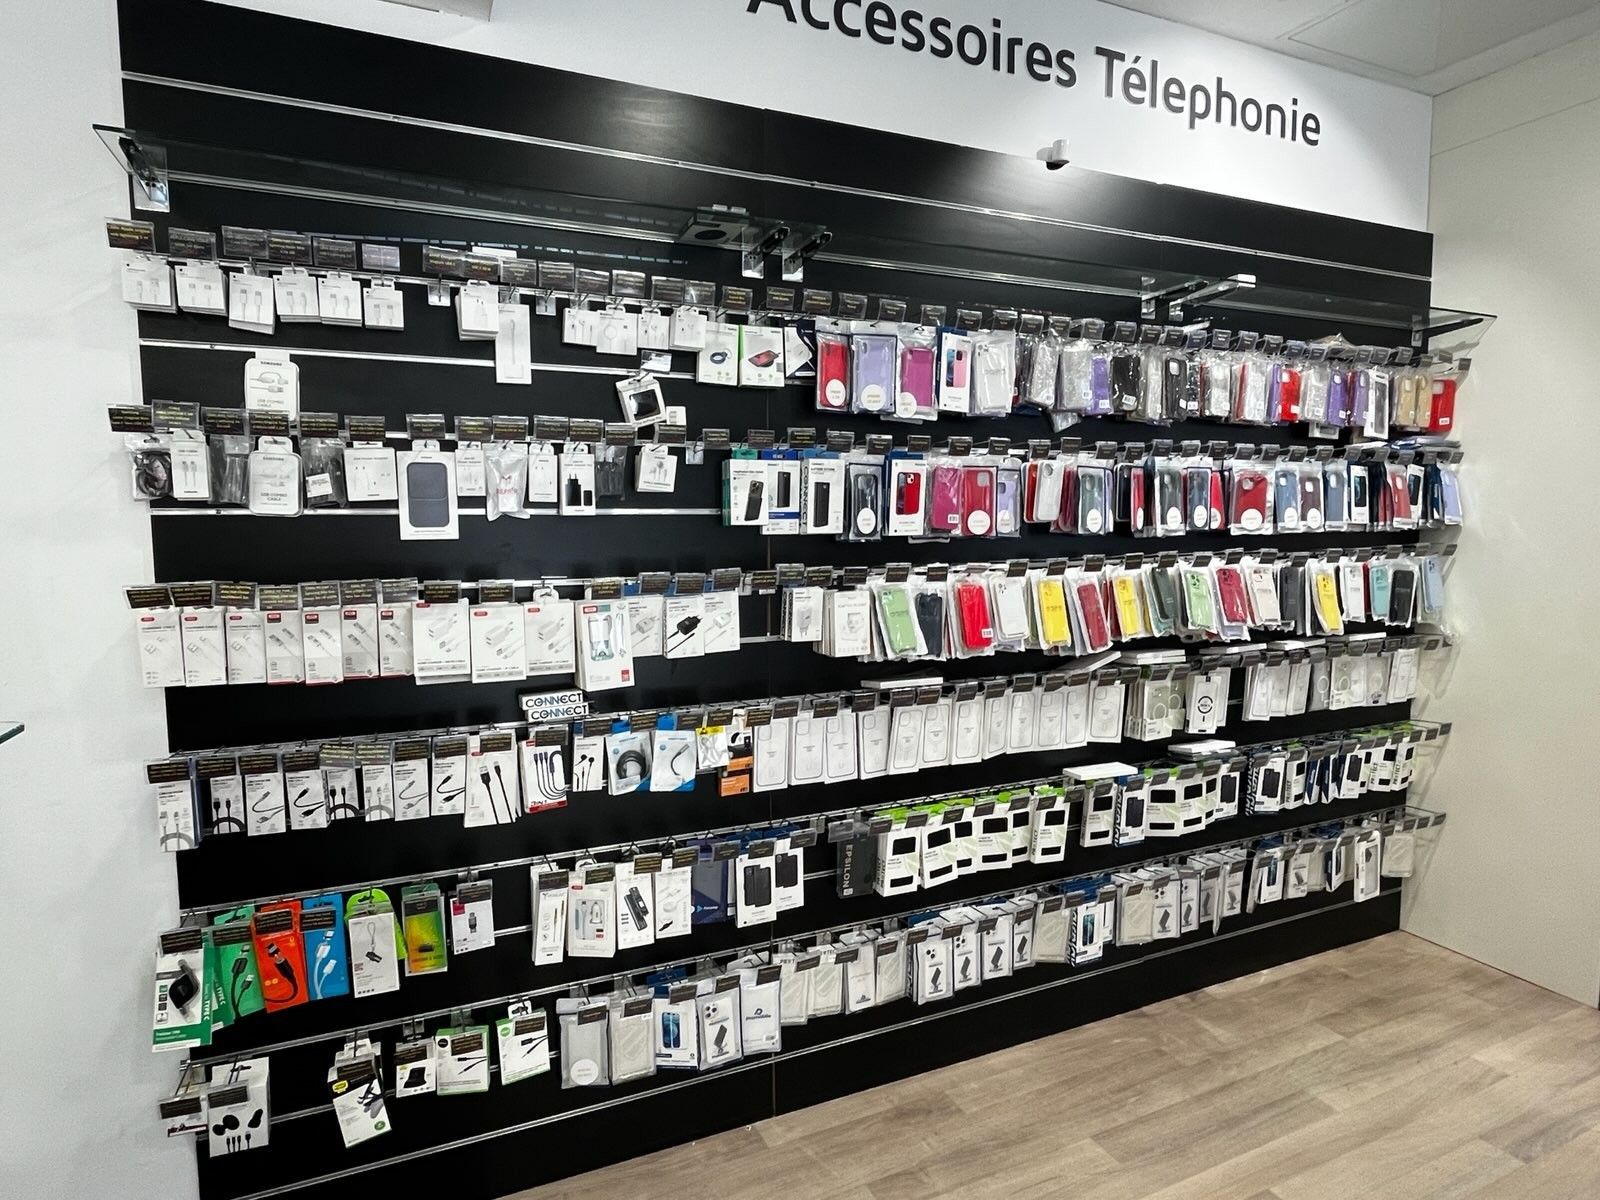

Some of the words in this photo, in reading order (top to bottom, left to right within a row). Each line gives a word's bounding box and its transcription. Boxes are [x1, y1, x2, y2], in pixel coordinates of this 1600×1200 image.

[746, 0, 1077, 88] ccessoires
[1095, 46, 1321, 147] Télephonie
[526, 693, 581, 708] CONNECT
[531, 705, 587, 720] CONNECT
[843, 844, 853, 888] EPSILON
